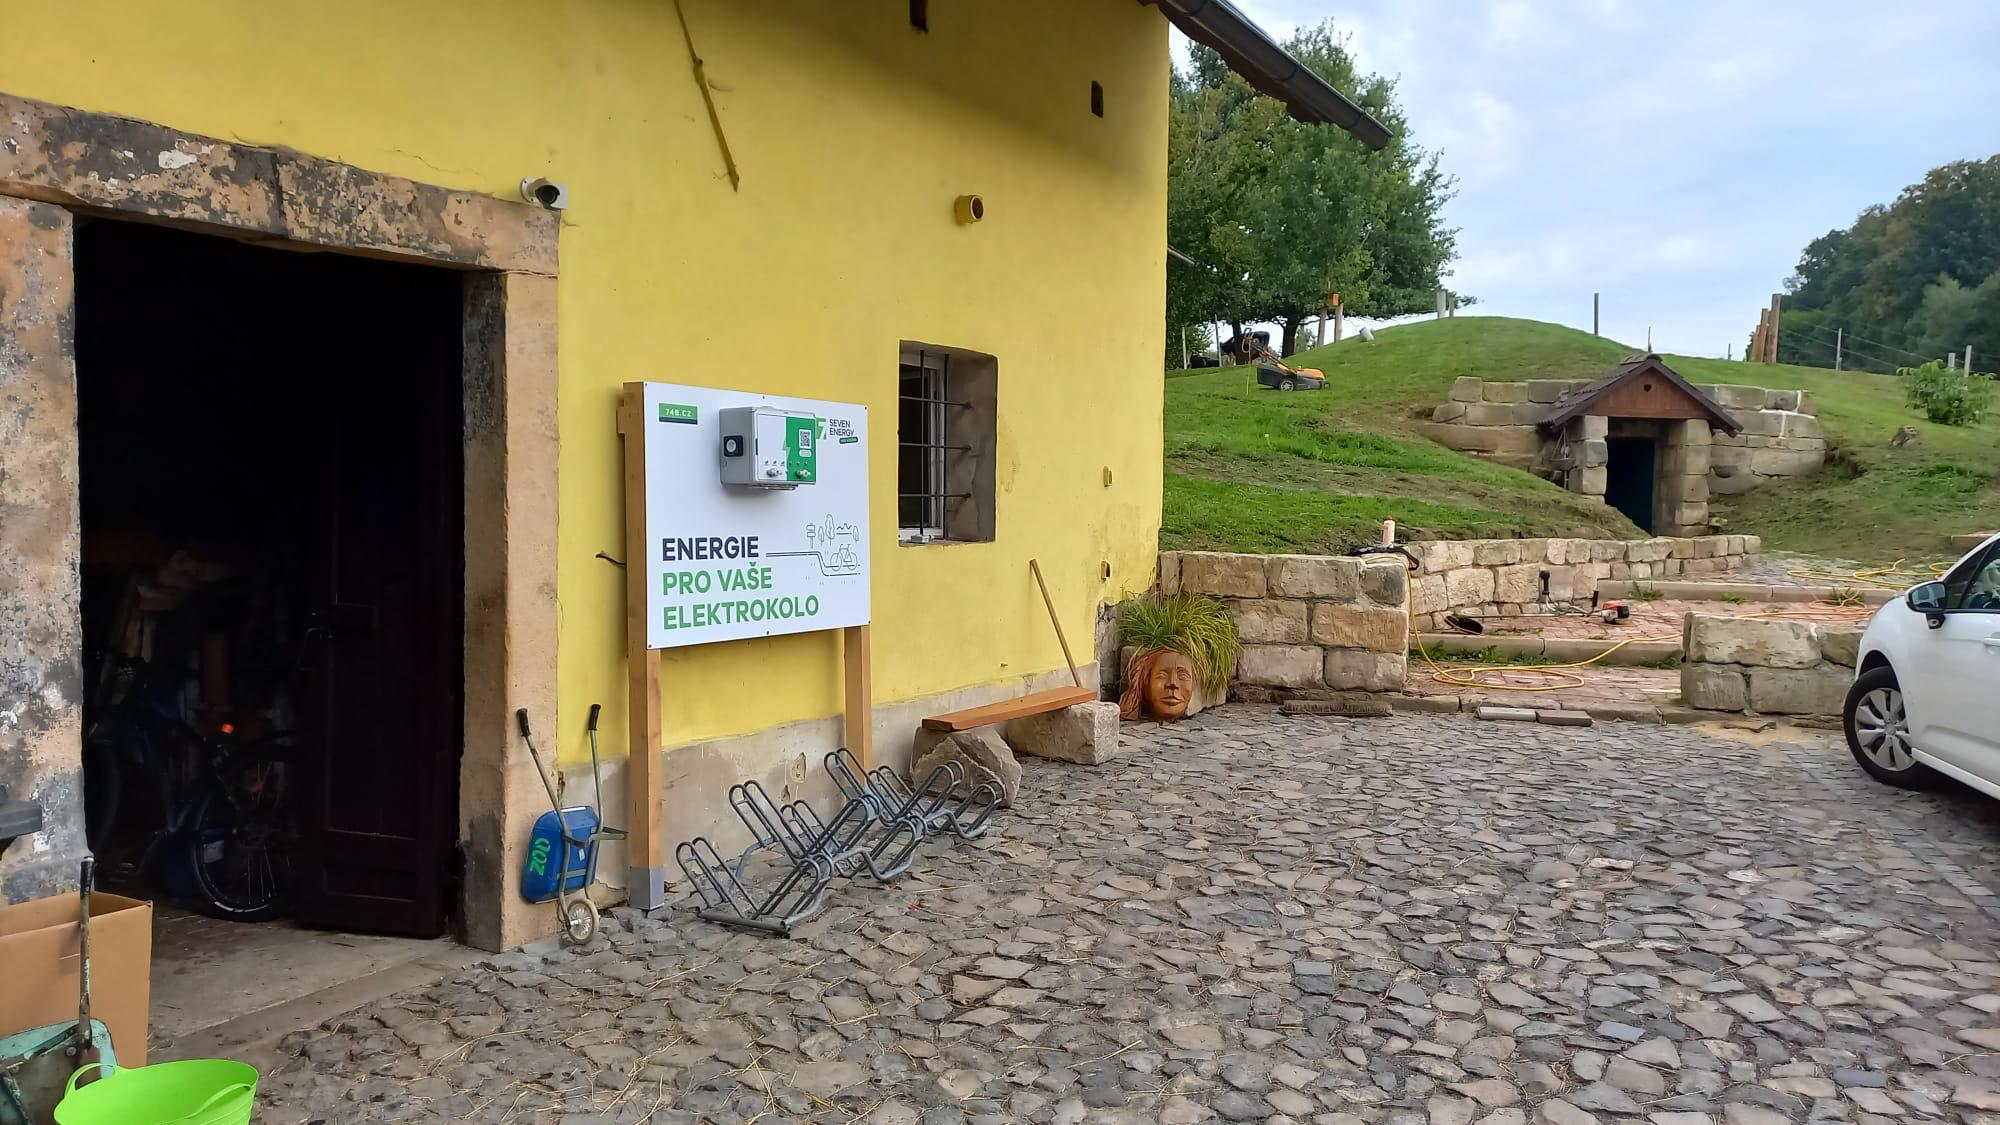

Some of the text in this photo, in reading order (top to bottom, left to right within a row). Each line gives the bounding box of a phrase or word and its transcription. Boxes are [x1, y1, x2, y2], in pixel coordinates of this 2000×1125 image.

[829, 419, 851, 428] SEVEN
[829, 427, 855, 437] ENERGY
[662, 536, 759, 561] ENERGIE
[663, 561, 773, 596] PRO VAŠE
[663, 595, 819, 630] ELEKTROKOLO
